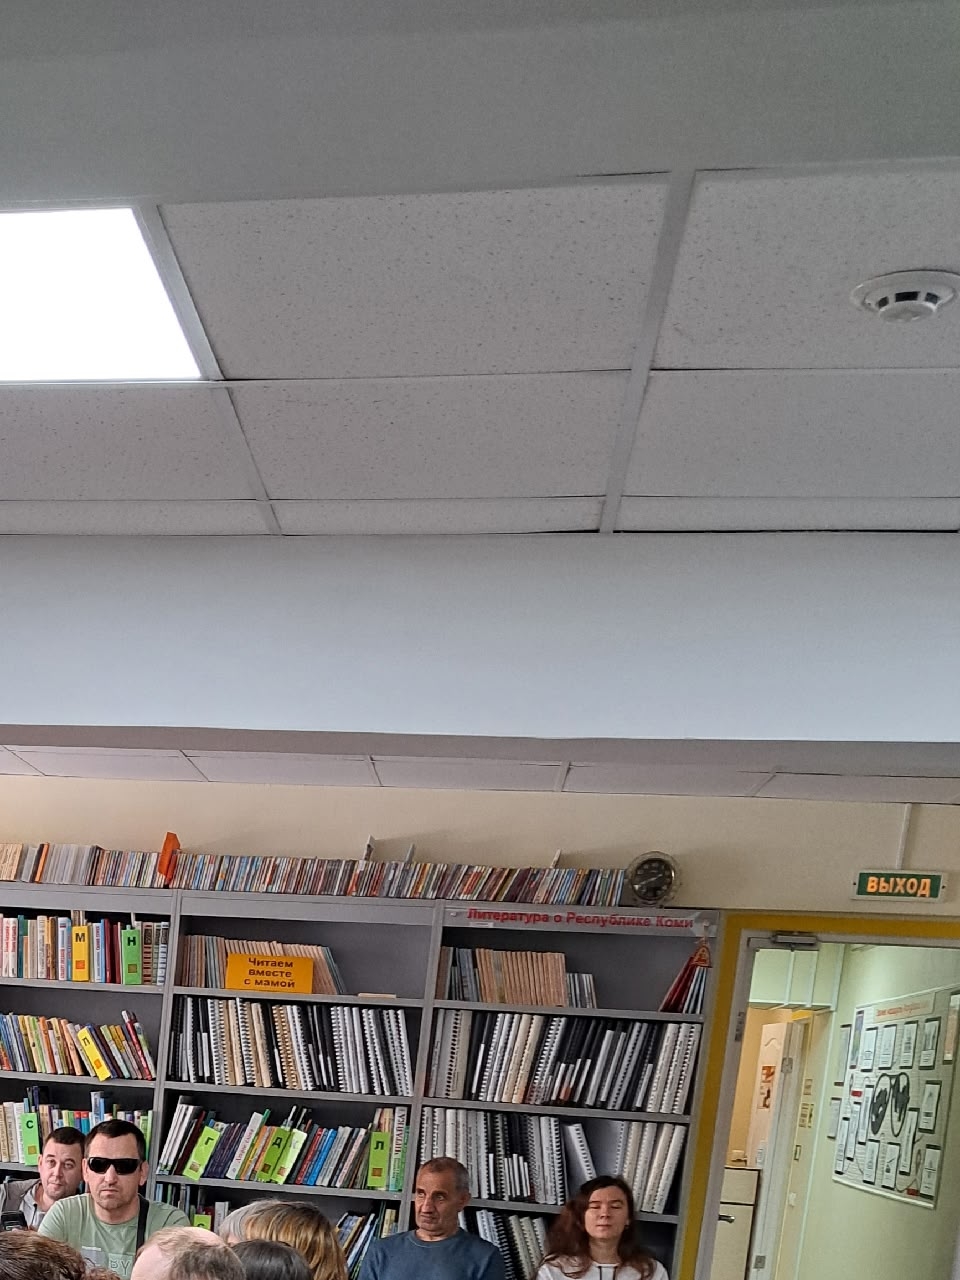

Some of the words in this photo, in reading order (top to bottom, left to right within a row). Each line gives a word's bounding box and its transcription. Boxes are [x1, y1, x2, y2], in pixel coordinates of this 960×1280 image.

[866, 876, 931, 898] ВЫХОД
[467, 908, 550, 925] Литература
[553, 913, 562, 924] о
[566, 911, 651, 929] Республике
[655, 915, 695, 929] Коми
[75, 932, 86, 943] М
[127, 936, 137, 947] Н
[248, 957, 294, 968] Читаем
[248, 969, 292, 978] вместе
[254, 978, 296, 988] мамой
[25, 1120, 34, 1129] С
